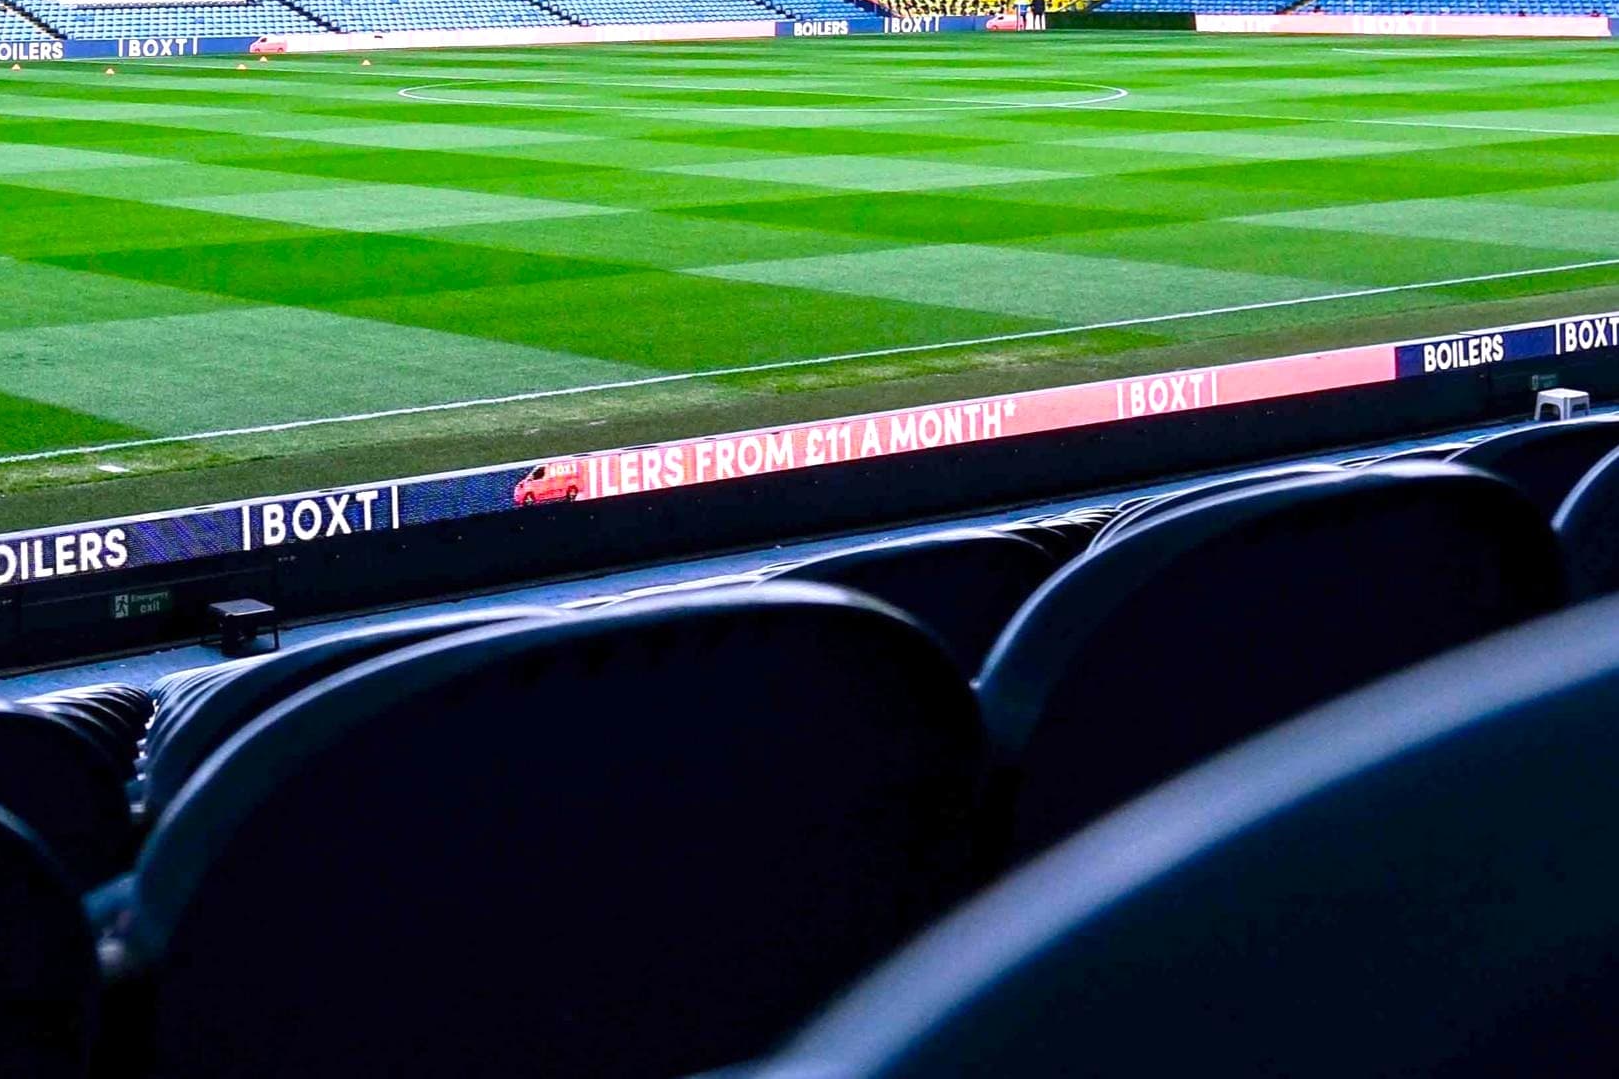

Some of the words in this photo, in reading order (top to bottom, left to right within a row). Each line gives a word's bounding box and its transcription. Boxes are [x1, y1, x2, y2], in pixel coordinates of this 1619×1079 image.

[793, 20, 848, 36] BOILERS
[891, 16, 929, 33] BOXT
[128, 38, 188, 57] BOXT
[1565, 318, 1619, 352] BOXT
[1423, 335, 1504, 372] BOILERS
[1130, 375, 1206, 416] BOXT
[588, 451, 682, 498] ILERS
[696, 433, 793, 484] FROM
[804, 429, 851, 467] £11
[859, 423, 882, 457] A
[262, 490, 378, 546] BOXT
[140, 600, 160, 614] exit
